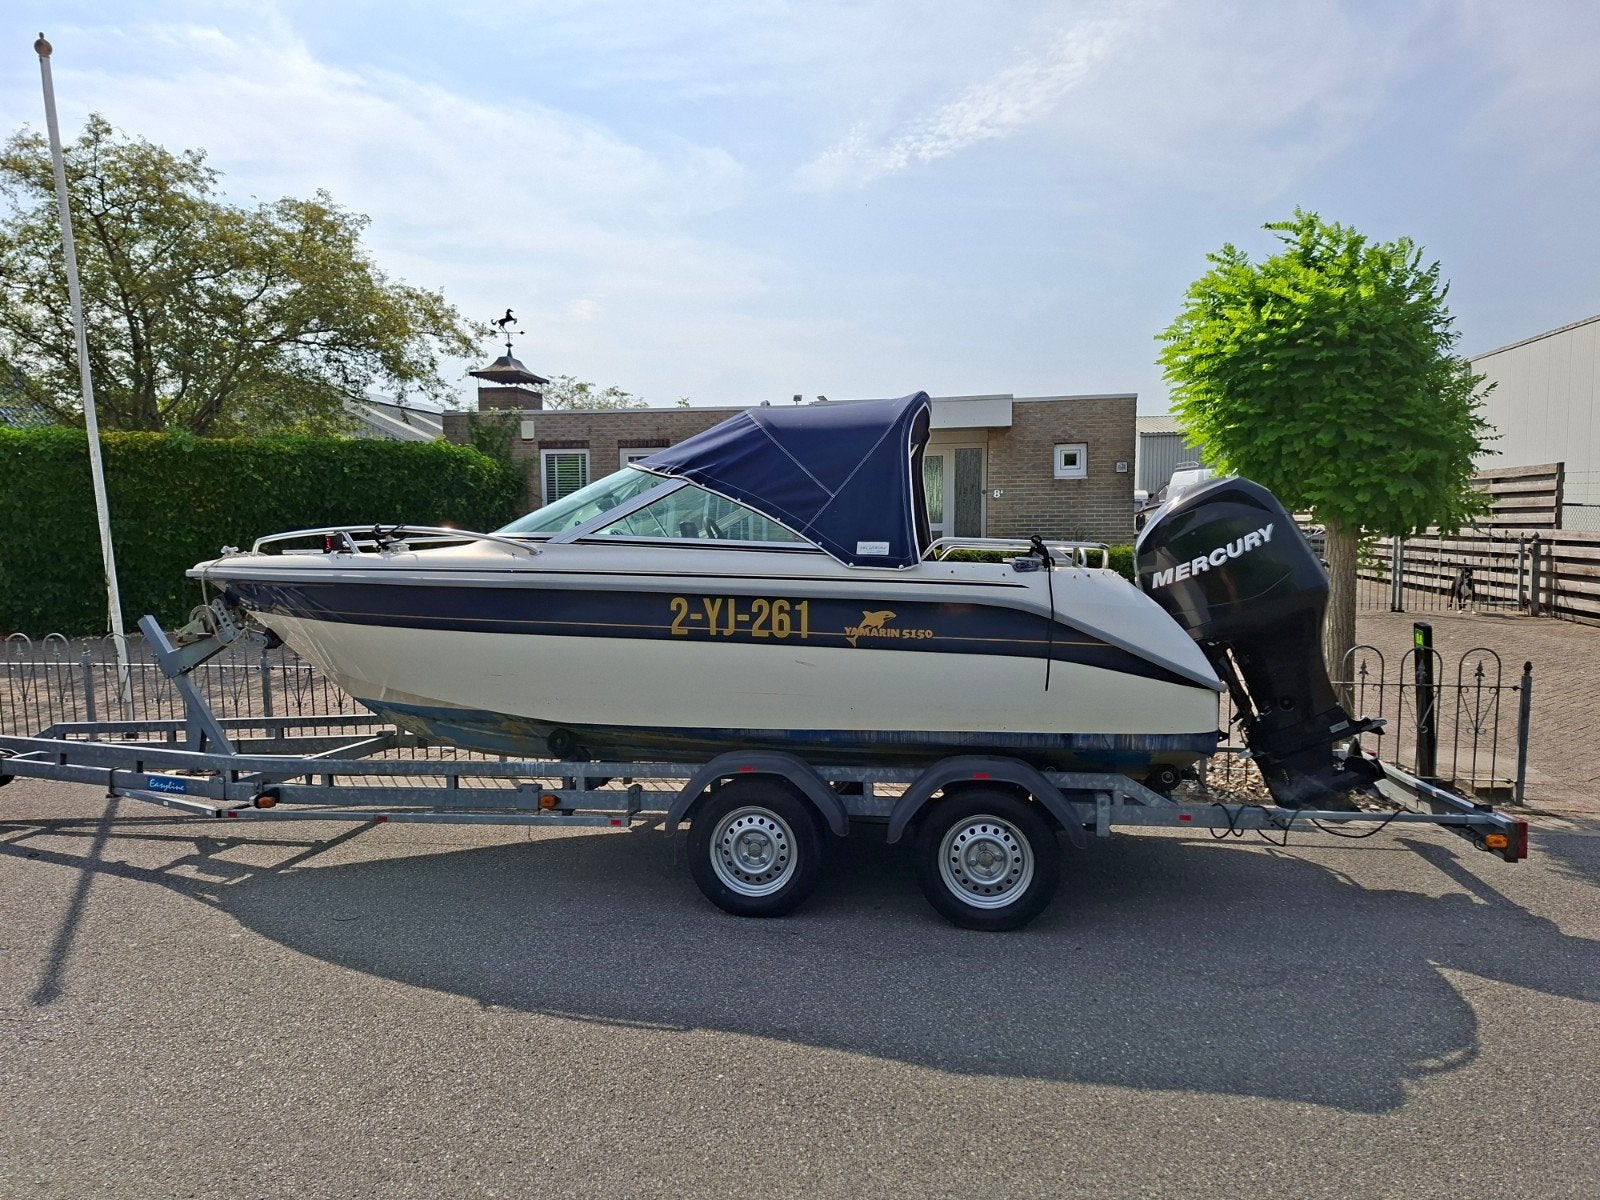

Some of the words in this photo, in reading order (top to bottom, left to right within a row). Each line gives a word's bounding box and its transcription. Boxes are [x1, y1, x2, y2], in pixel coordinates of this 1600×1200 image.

[1152, 523, 1275, 589] MERCURY
[671, 597, 808, 638] 2-YJ-261
[844, 627, 899, 638] YAMARIN
[149, 778, 185, 791] Easyline
